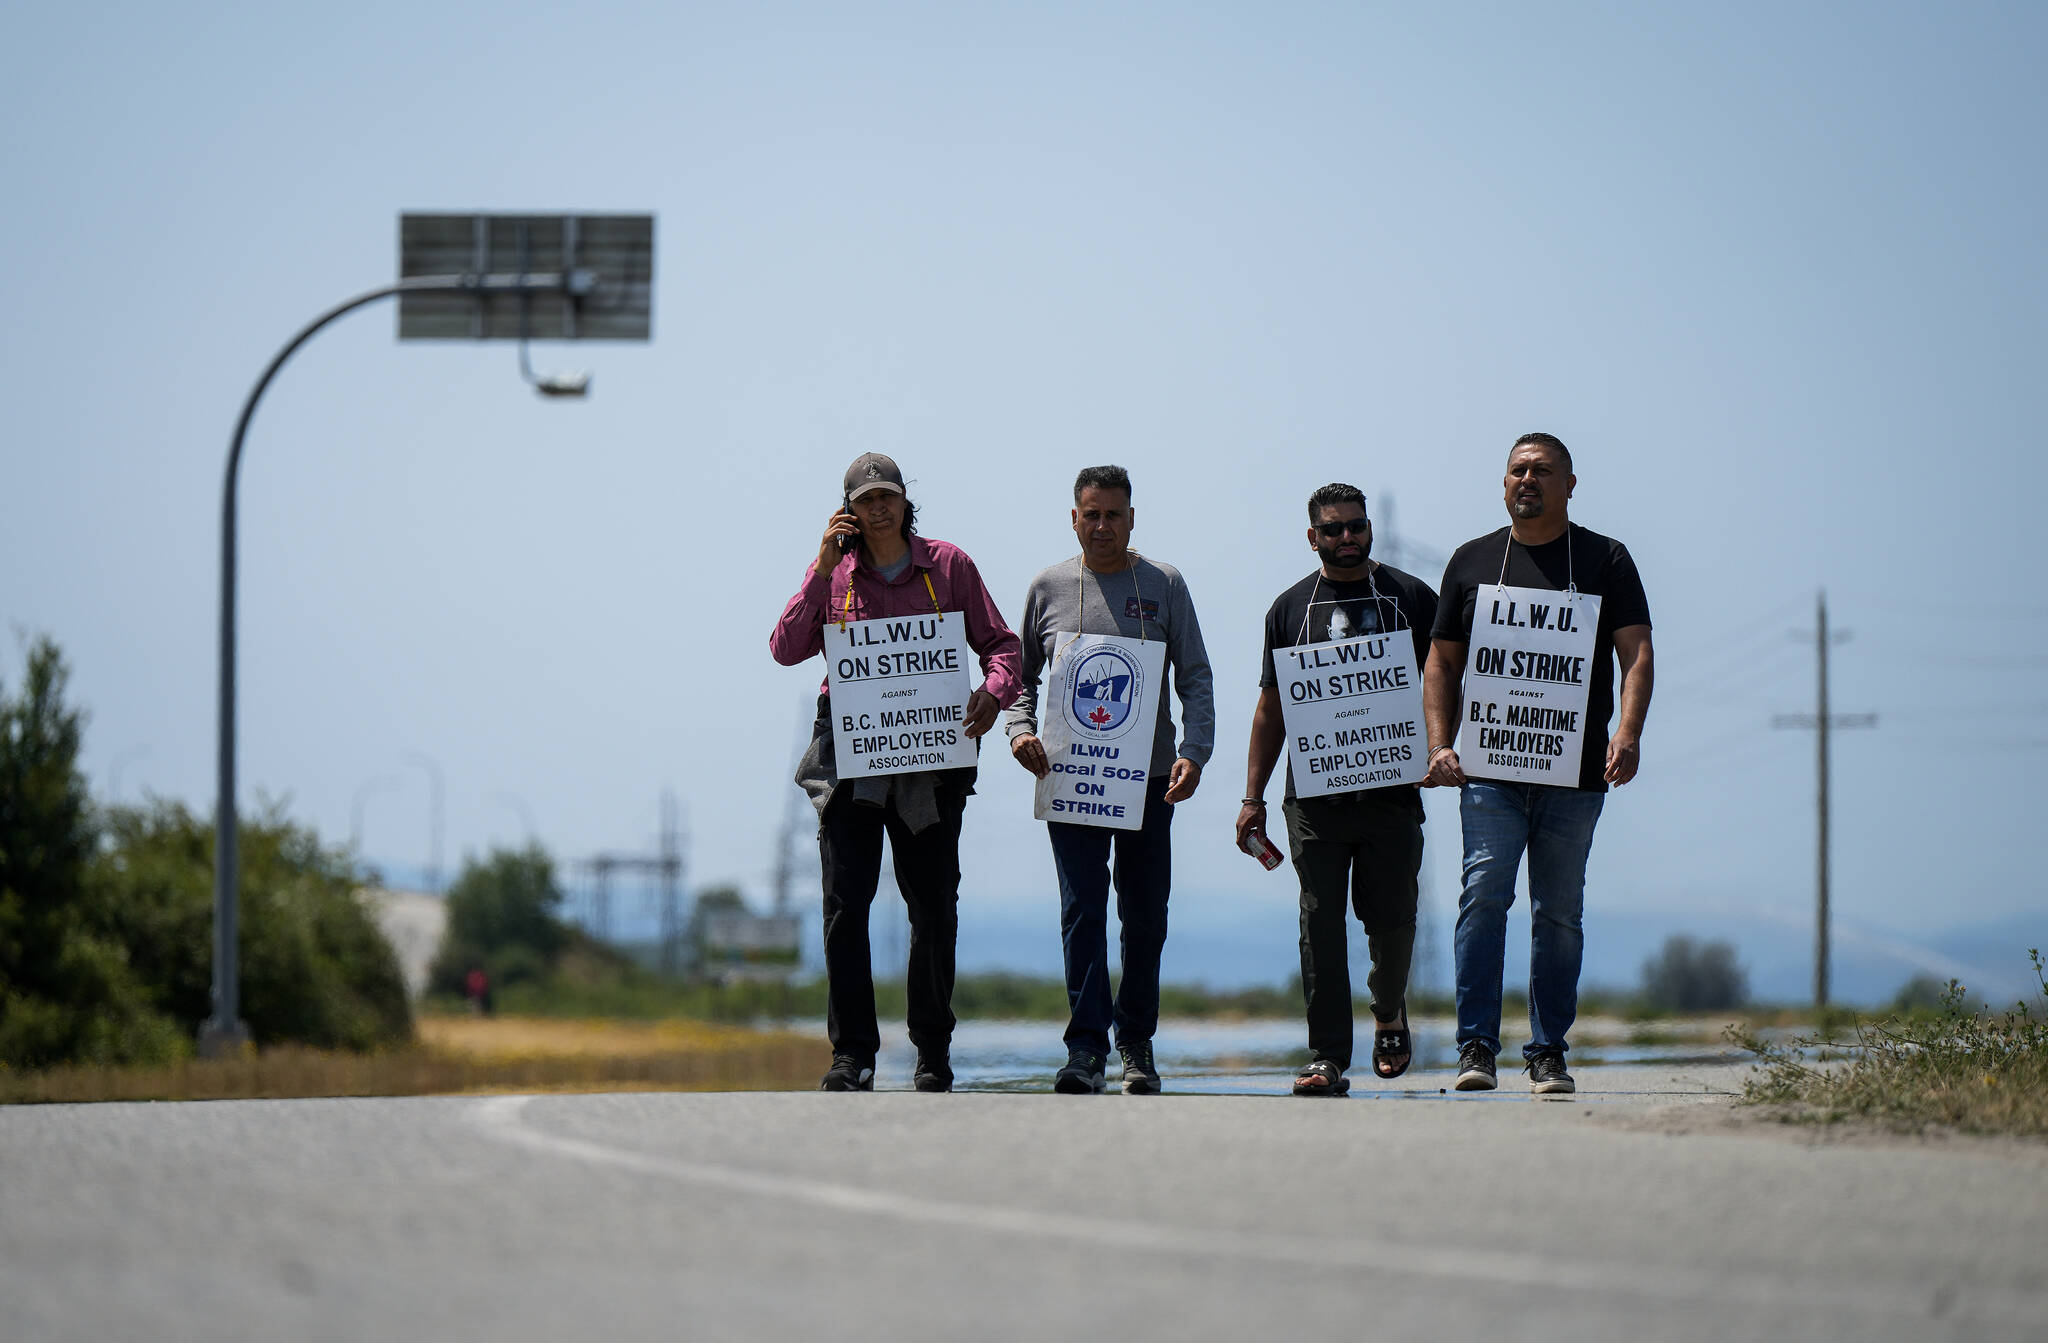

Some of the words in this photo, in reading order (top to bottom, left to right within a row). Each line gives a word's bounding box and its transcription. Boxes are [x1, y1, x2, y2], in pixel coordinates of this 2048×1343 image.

[1490, 600, 1578, 633] I.L.W.U.
[849, 619, 943, 647] I.L.W.U.
[838, 656, 871, 680] ON
[877, 649, 959, 675] STRIKE
[1475, 646, 1506, 675] ON
[1510, 650, 1585, 683] STRIKE
[881, 689, 918, 699] AGAINST
[1290, 678, 1323, 701] ON
[1329, 666, 1409, 696] STRIKE
[1508, 689, 1545, 699] AGAINST
[842, 714, 876, 732] B.C.
[880, 705, 963, 728] MARITIME
[1334, 708, 1370, 719] AGAINST
[1470, 701, 1501, 725] B.C.
[1506, 704, 1579, 732] MARITIME
[852, 729, 957, 754] EMPLOYERS
[1298, 734, 1331, 752] B.C.
[1335, 721, 1417, 747] MARITIME
[1479, 727, 1564, 757] EMPLOYERS
[868, 752, 945, 770] ASSOCIATION
[1070, 743, 1120, 760] ILWU
[1309, 744, 1413, 774] EMPLOYERS
[1487, 752, 1552, 771] ASSOCIATION
[1049, 763, 1096, 776] ocal
[1102, 766, 1146, 782] 502
[1326, 768, 1402, 789] ASSOCIATION
[1074, 782, 1105, 796] ON
[1051, 799, 1126, 818] STRIKE
